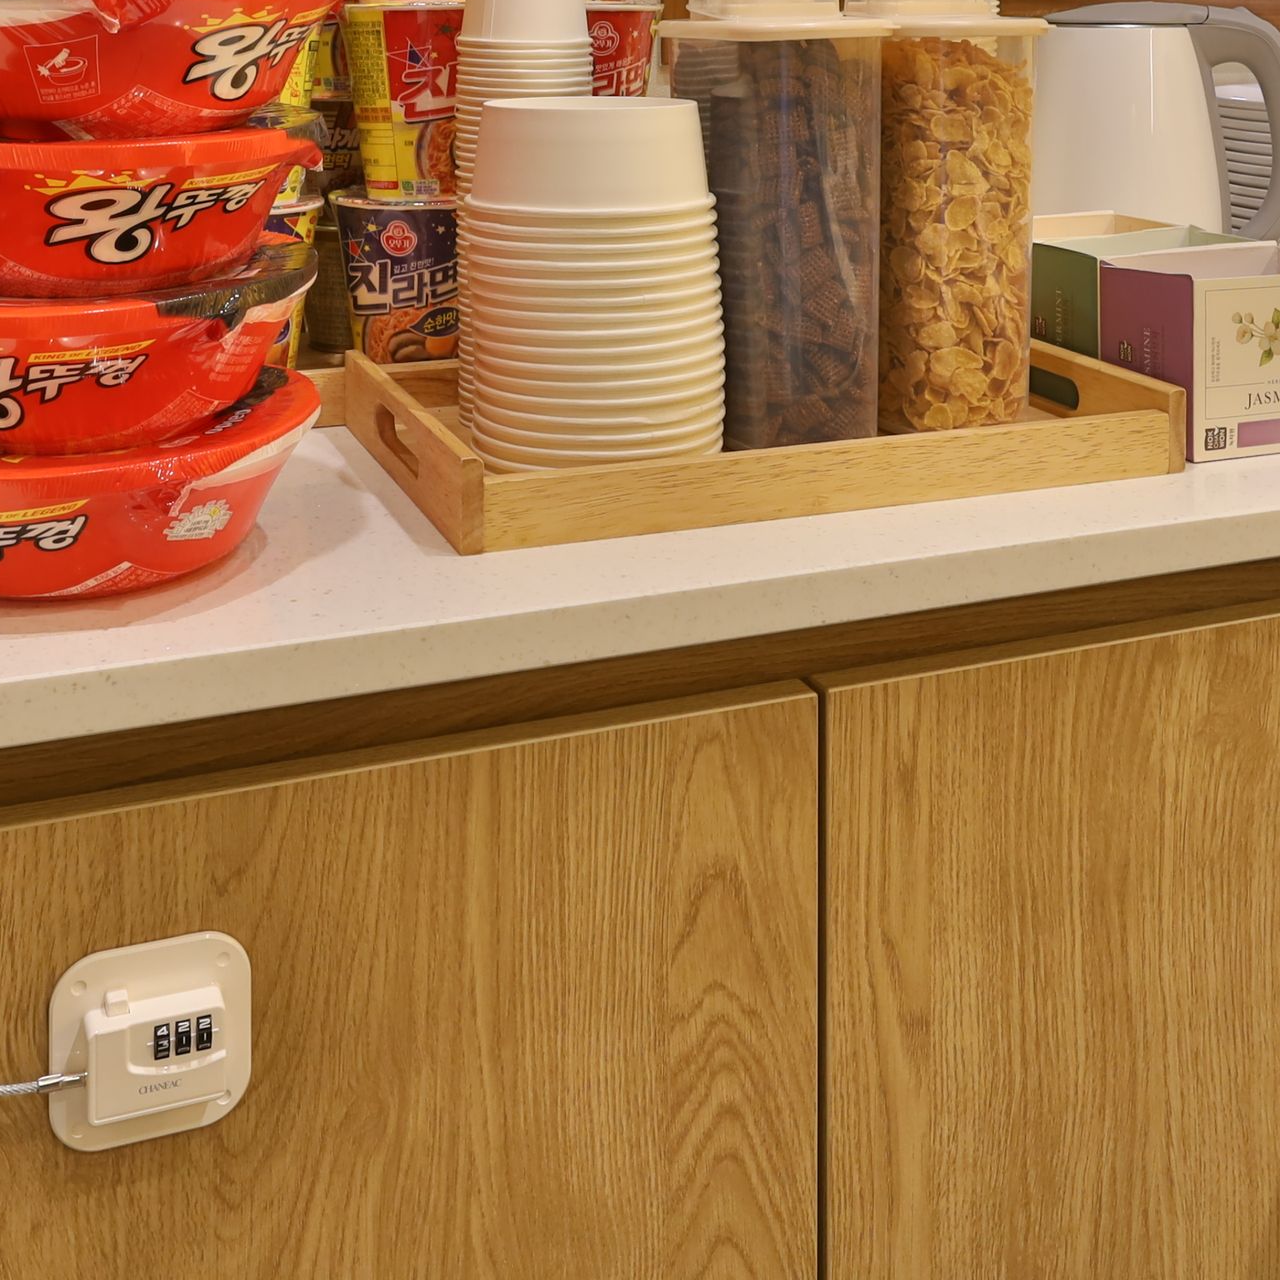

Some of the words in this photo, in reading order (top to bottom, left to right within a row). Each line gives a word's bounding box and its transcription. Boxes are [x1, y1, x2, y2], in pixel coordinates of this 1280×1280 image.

[44, 178, 268, 265] 왕뚜껑
[423, 310, 457, 333] 순한맛
[33, 352, 66, 361] KING
[84, 342, 144, 358] LEGEND
[21, 502, 79, 519] LEGEND
[138, 1078, 183, 1096] CHANEAC
